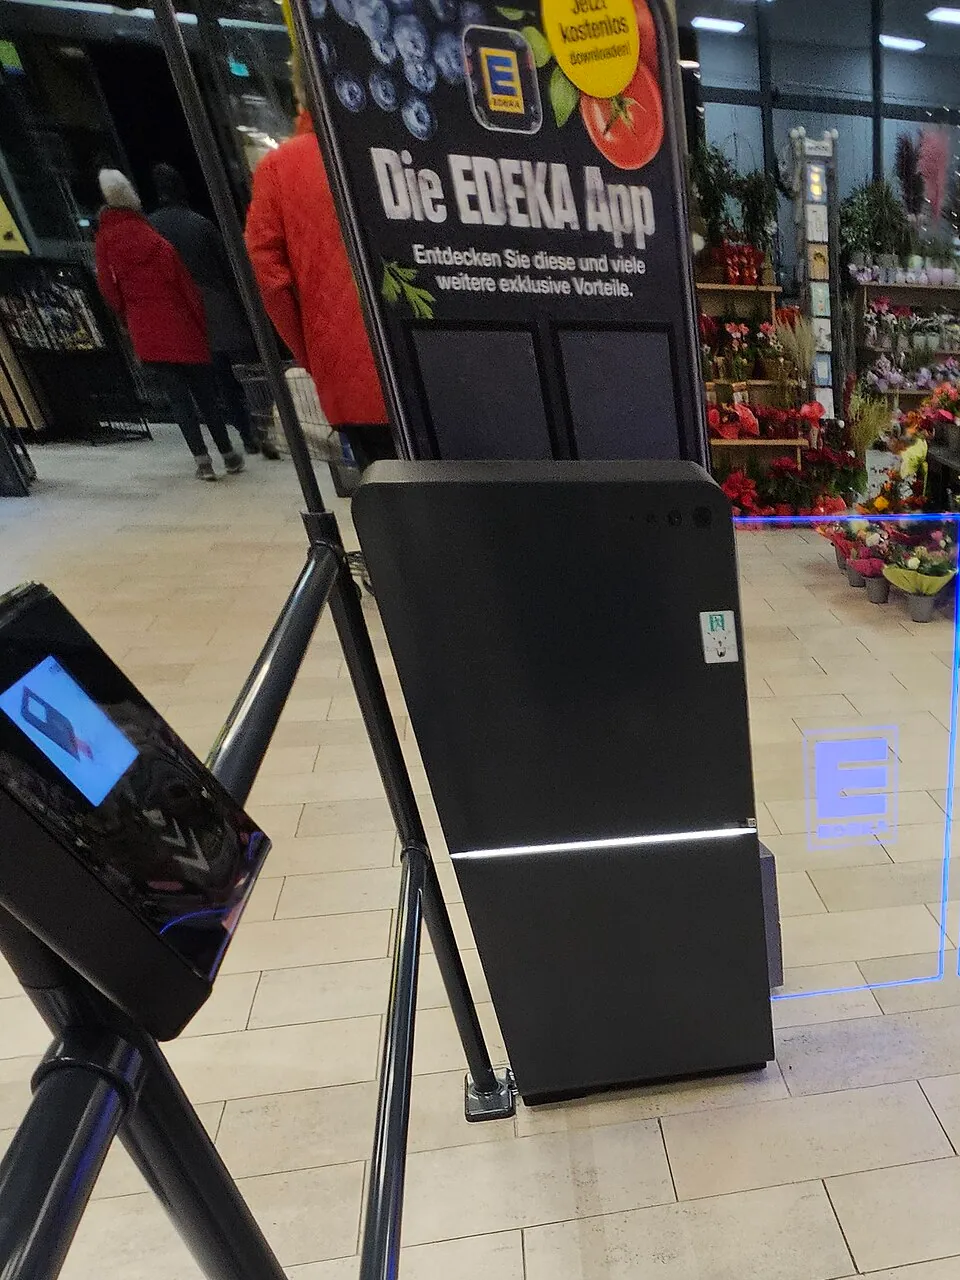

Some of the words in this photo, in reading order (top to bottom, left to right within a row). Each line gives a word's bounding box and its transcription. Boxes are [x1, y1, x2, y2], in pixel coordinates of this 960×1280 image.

[558, 15, 630, 44] kostenlos
[370, 146, 447, 223] Die
[447, 153, 580, 231] EDEKA
[583, 165, 656, 250] App
[412, 243, 501, 268] Entdecken
[503, 248, 531, 269] Sie
[532, 251, 576, 271] diese
[577, 253, 609, 273] und
[610, 255, 646, 275] viele
[435, 272, 497, 292] weitere
[499, 274, 571, 295] exklusive
[571, 276, 634, 297] Vorteile.
